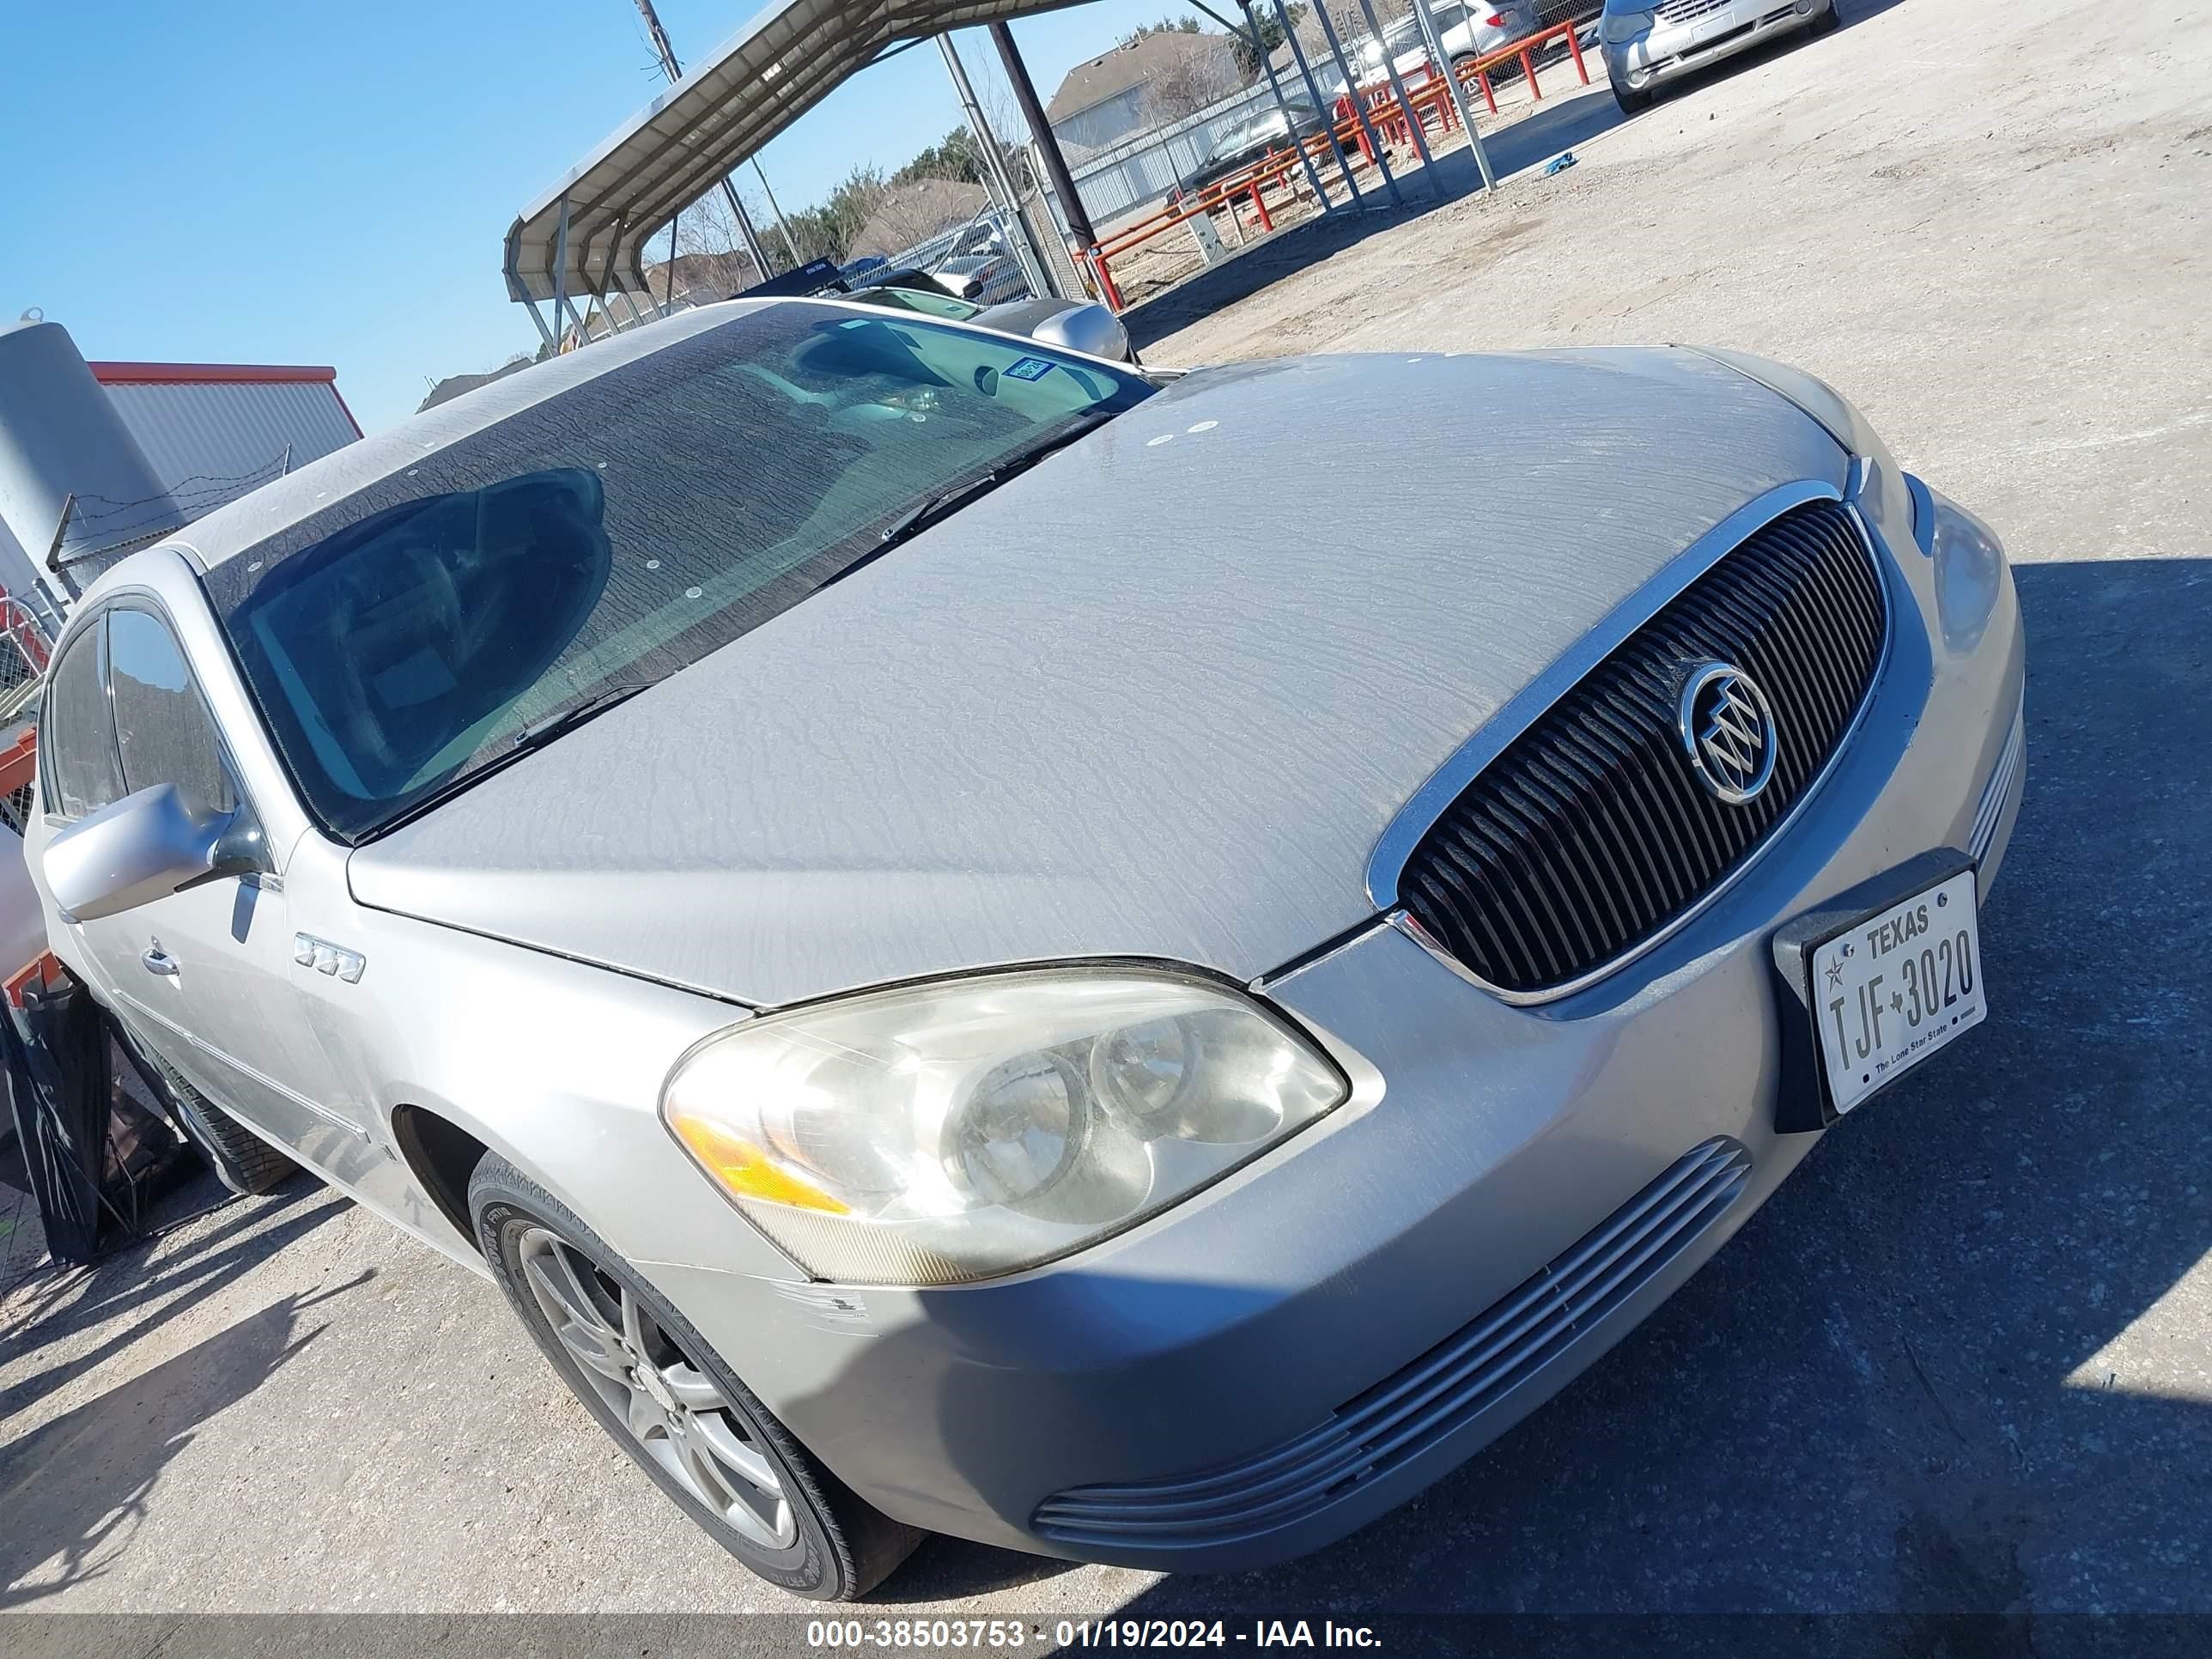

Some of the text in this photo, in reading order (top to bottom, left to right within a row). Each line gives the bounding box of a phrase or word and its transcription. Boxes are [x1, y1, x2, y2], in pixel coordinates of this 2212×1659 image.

[1867, 904, 1929, 960] TEXAS
[1830, 929, 1973, 1071] TJF 3020
[1875, 1024, 1948, 1075] The Lone Star State
